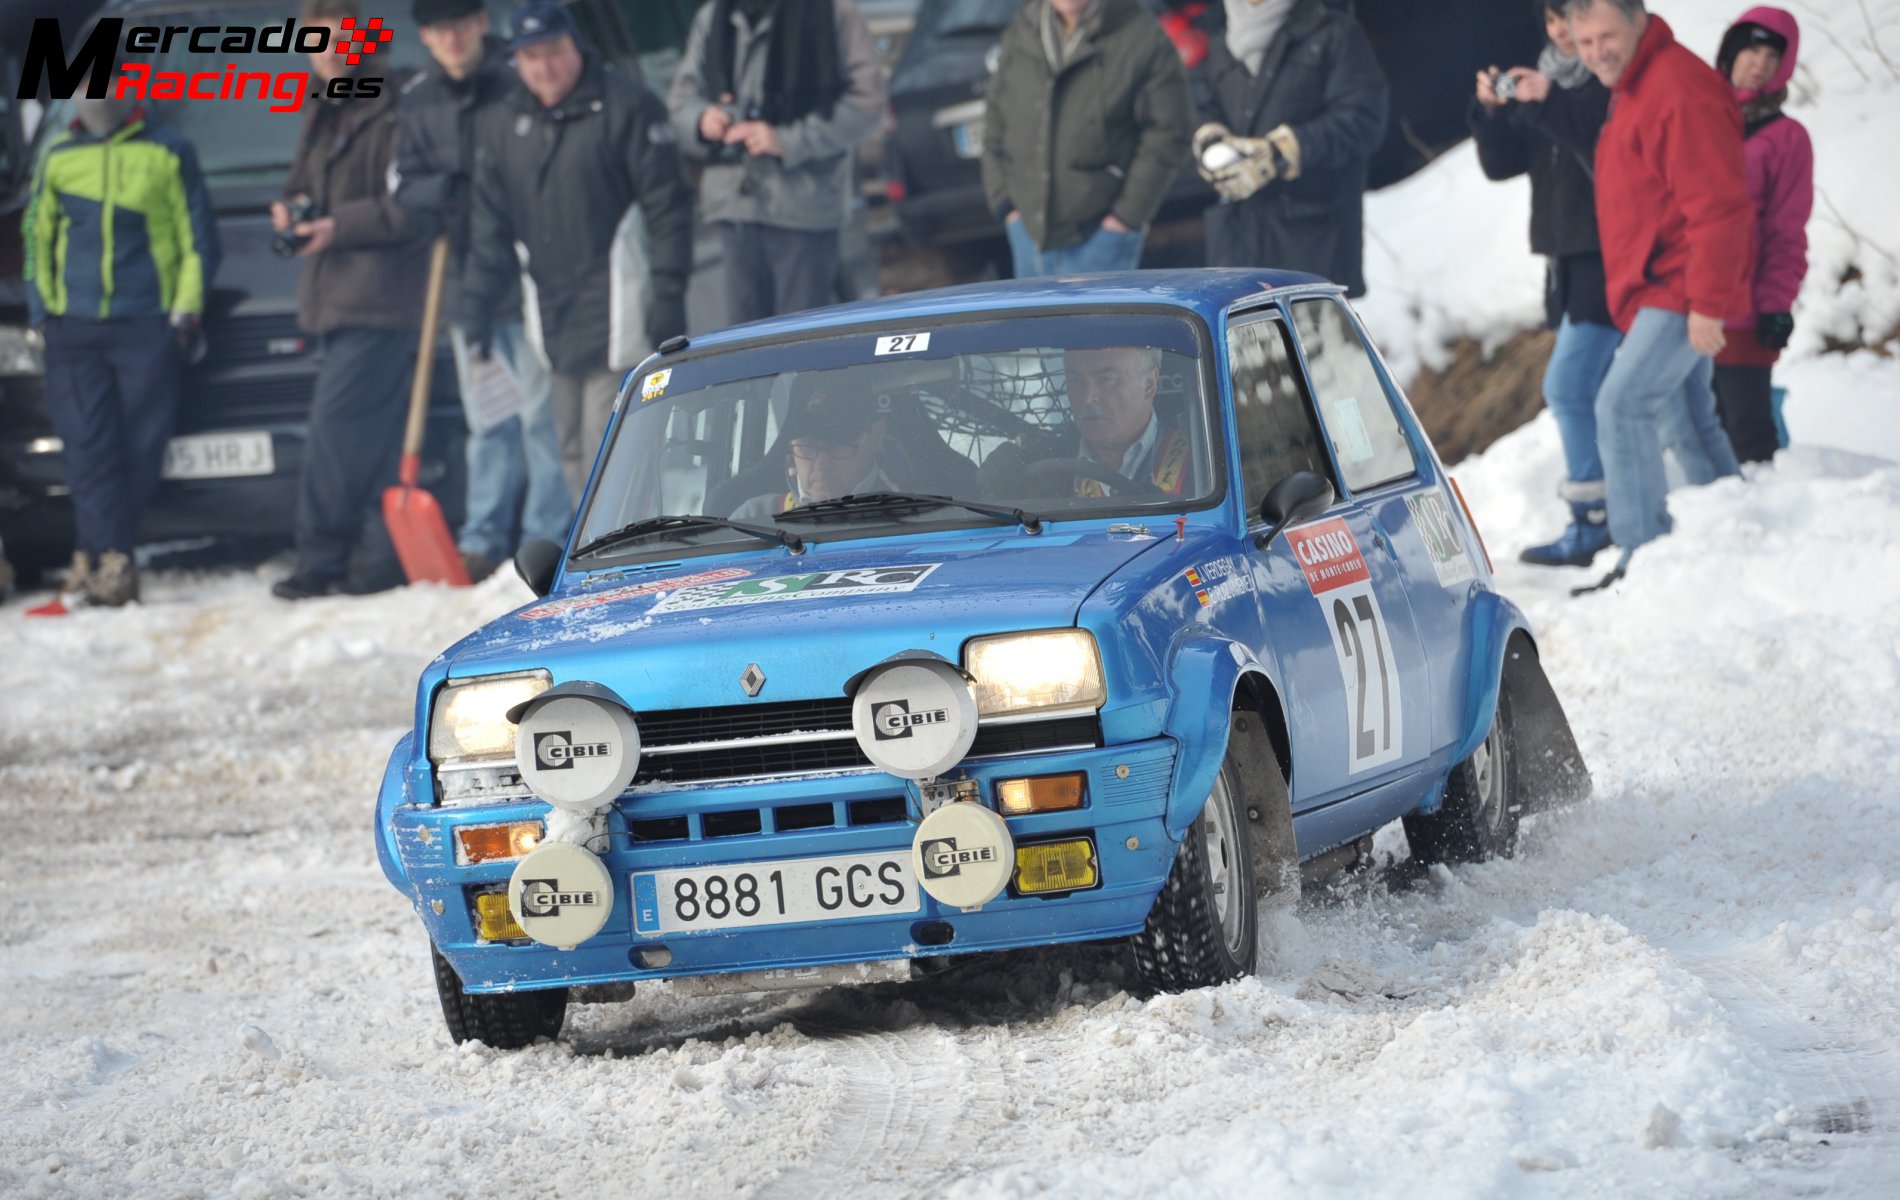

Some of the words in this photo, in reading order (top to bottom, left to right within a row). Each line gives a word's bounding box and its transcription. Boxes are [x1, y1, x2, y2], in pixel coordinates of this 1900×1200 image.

[889, 335, 917, 352] 27
[203, 438, 264, 468] HRJ
[1297, 530, 1353, 566] CASINO
[729, 570, 922, 598] SRC
[1309, 571, 1320, 583] DE
[1320, 559, 1362, 581] MONTE-CARLO
[1333, 594, 1391, 760] 27
[674, 870, 786, 922] 8881
[815, 861, 905, 911] GCS
[643, 909, 653, 921] E
